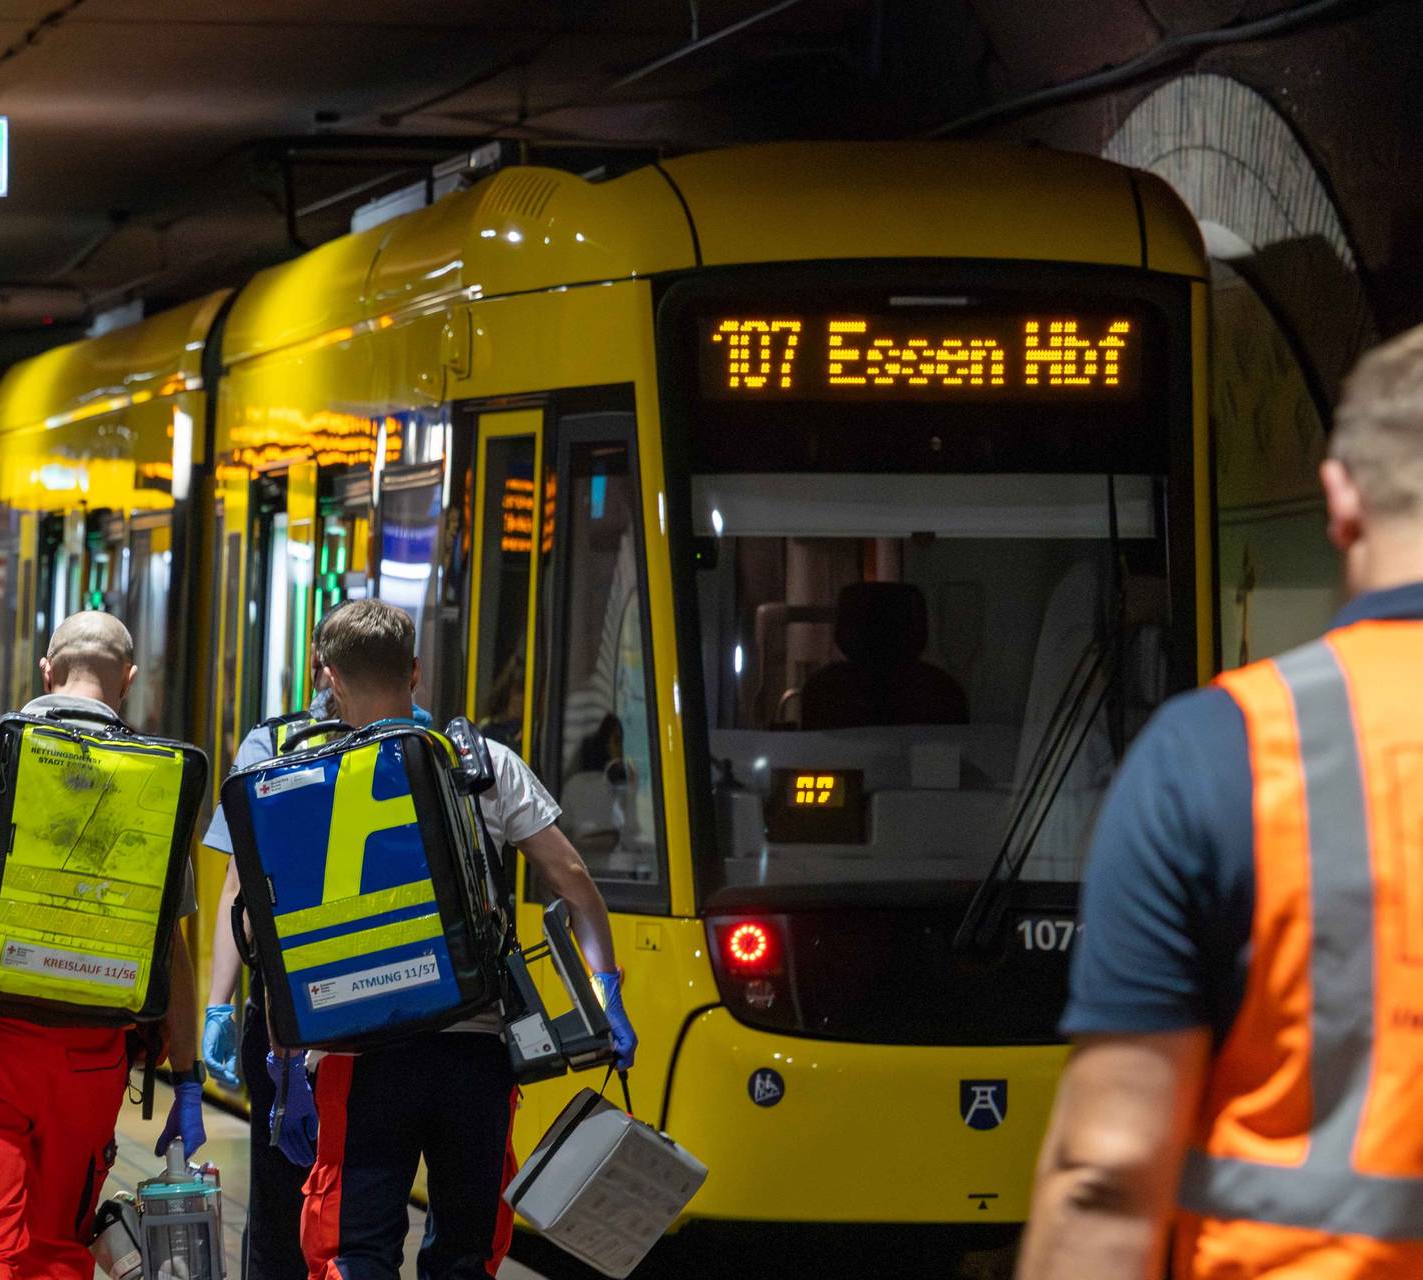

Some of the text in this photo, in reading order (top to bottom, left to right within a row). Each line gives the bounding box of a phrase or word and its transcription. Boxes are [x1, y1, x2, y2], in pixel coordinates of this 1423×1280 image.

[713, 320, 1130, 388] 107 Essen Hbf
[38, 757, 65, 767] STADT
[43, 956, 102, 975] KREISLAUF
[104, 967, 136, 980] 11/56
[351, 971, 402, 992] ATMUNG
[405, 963, 436, 979] 11/57
